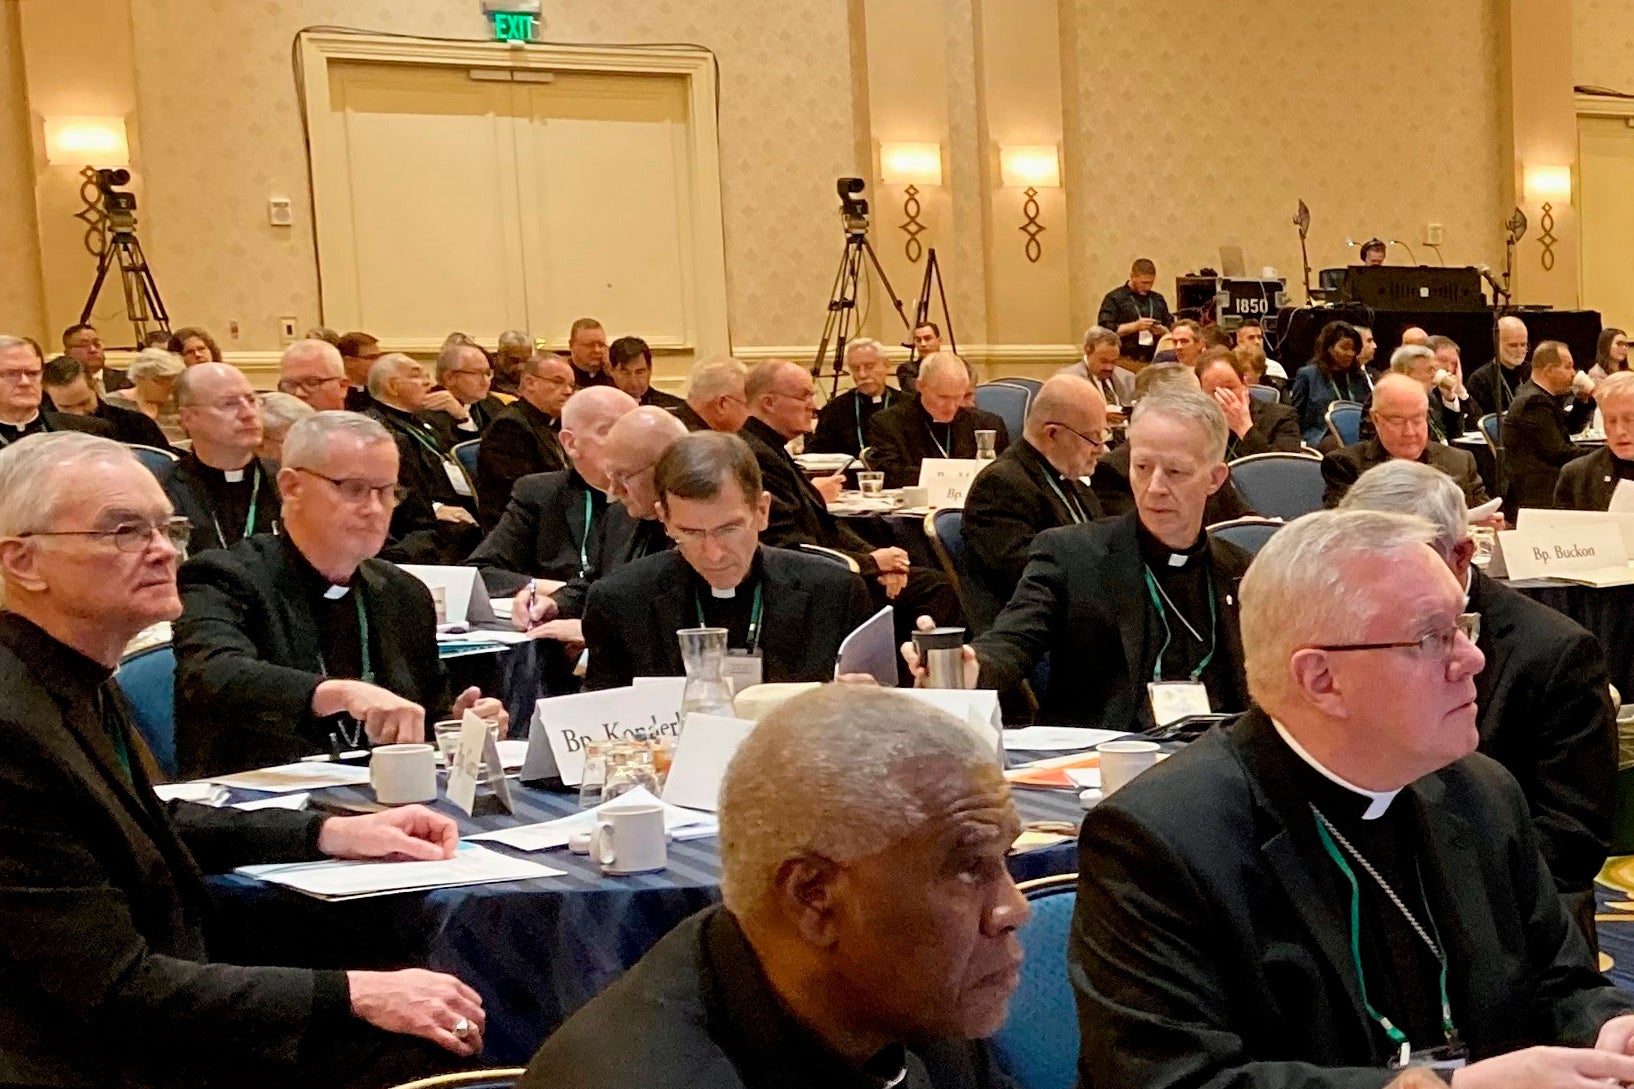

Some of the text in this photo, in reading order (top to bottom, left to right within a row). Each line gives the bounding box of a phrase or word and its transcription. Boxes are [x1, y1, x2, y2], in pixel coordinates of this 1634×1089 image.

[494, 13, 534, 39] EXIT
[1235, 298, 1268, 314] 1850
[1532, 543, 1596, 564] Bp. Buckon
